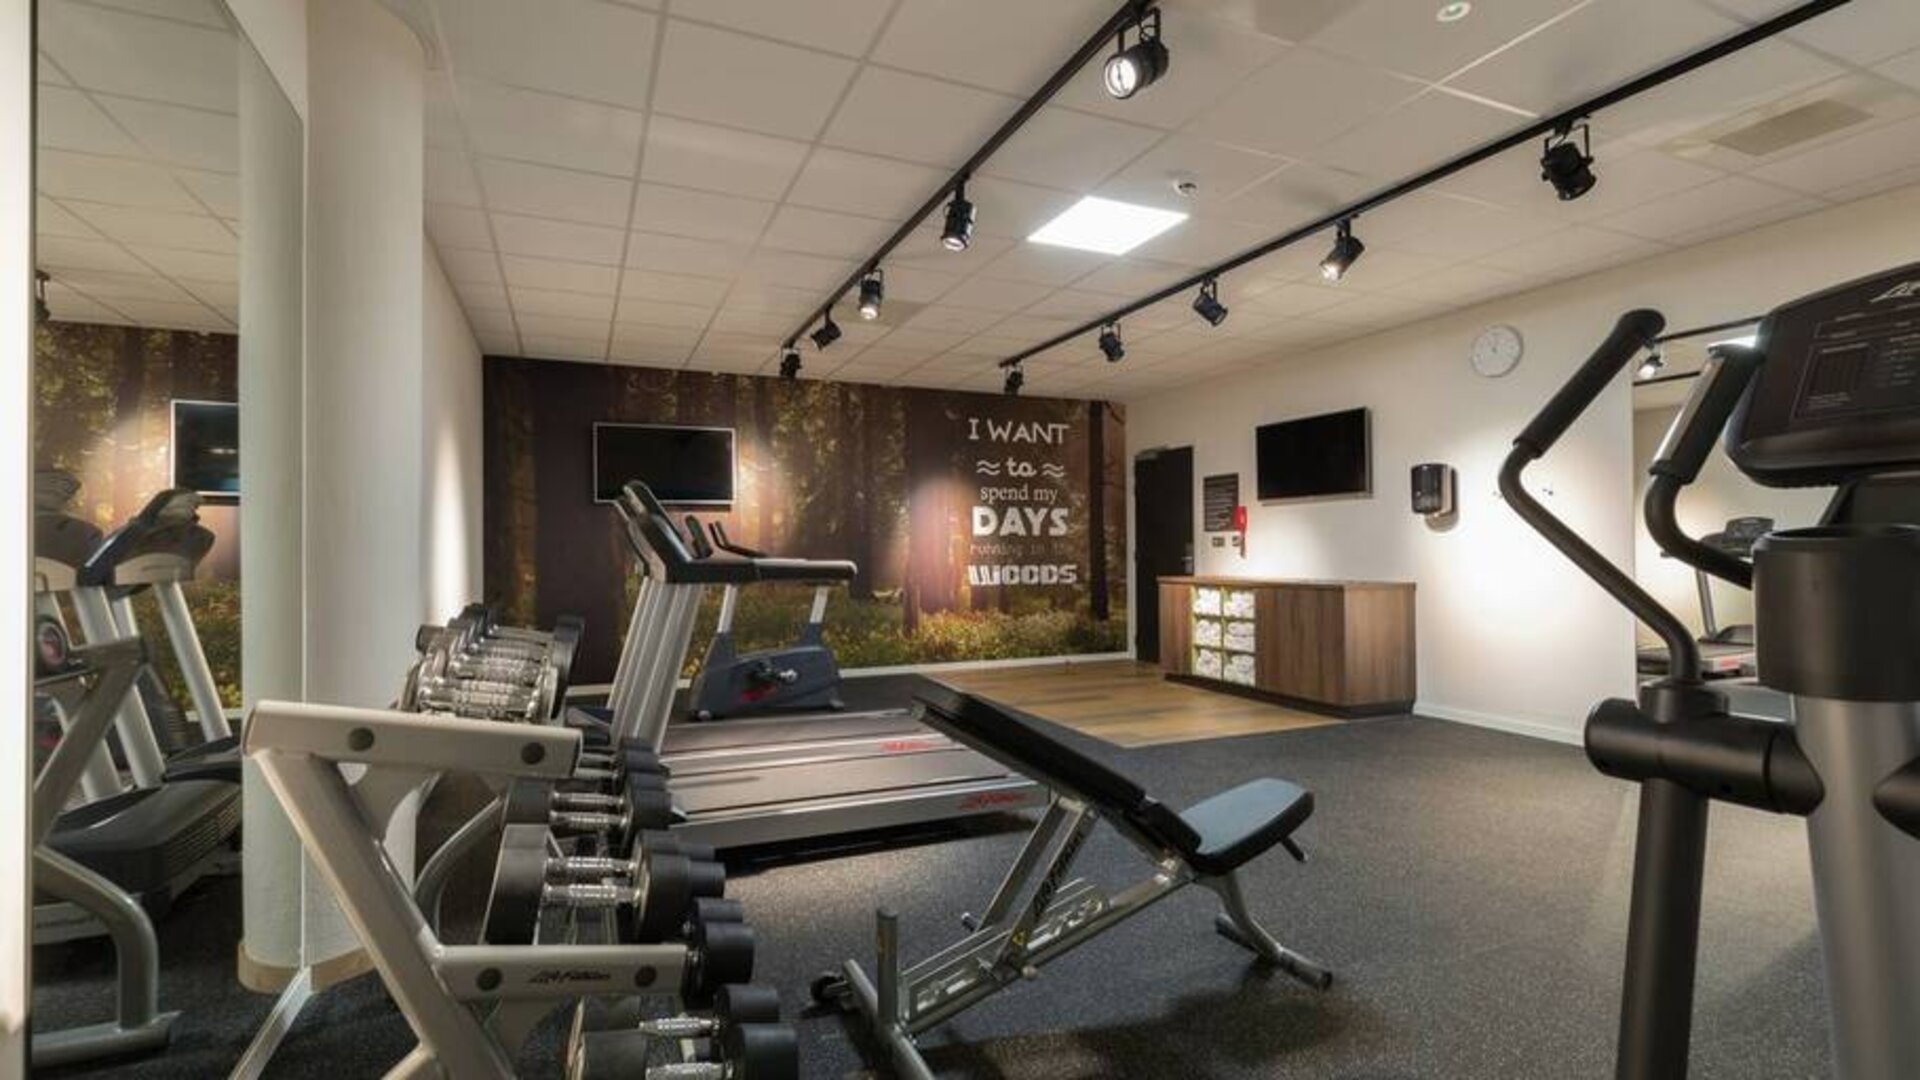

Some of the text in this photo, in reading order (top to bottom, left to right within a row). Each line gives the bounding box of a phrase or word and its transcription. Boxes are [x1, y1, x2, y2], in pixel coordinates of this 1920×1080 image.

[968, 418, 1070, 444] I WANT
[1006, 457, 1037, 478] to
[980, 484, 1058, 505] spend my
[972, 506, 1069, 537] DAYS
[967, 564, 1078, 586] WOODS
